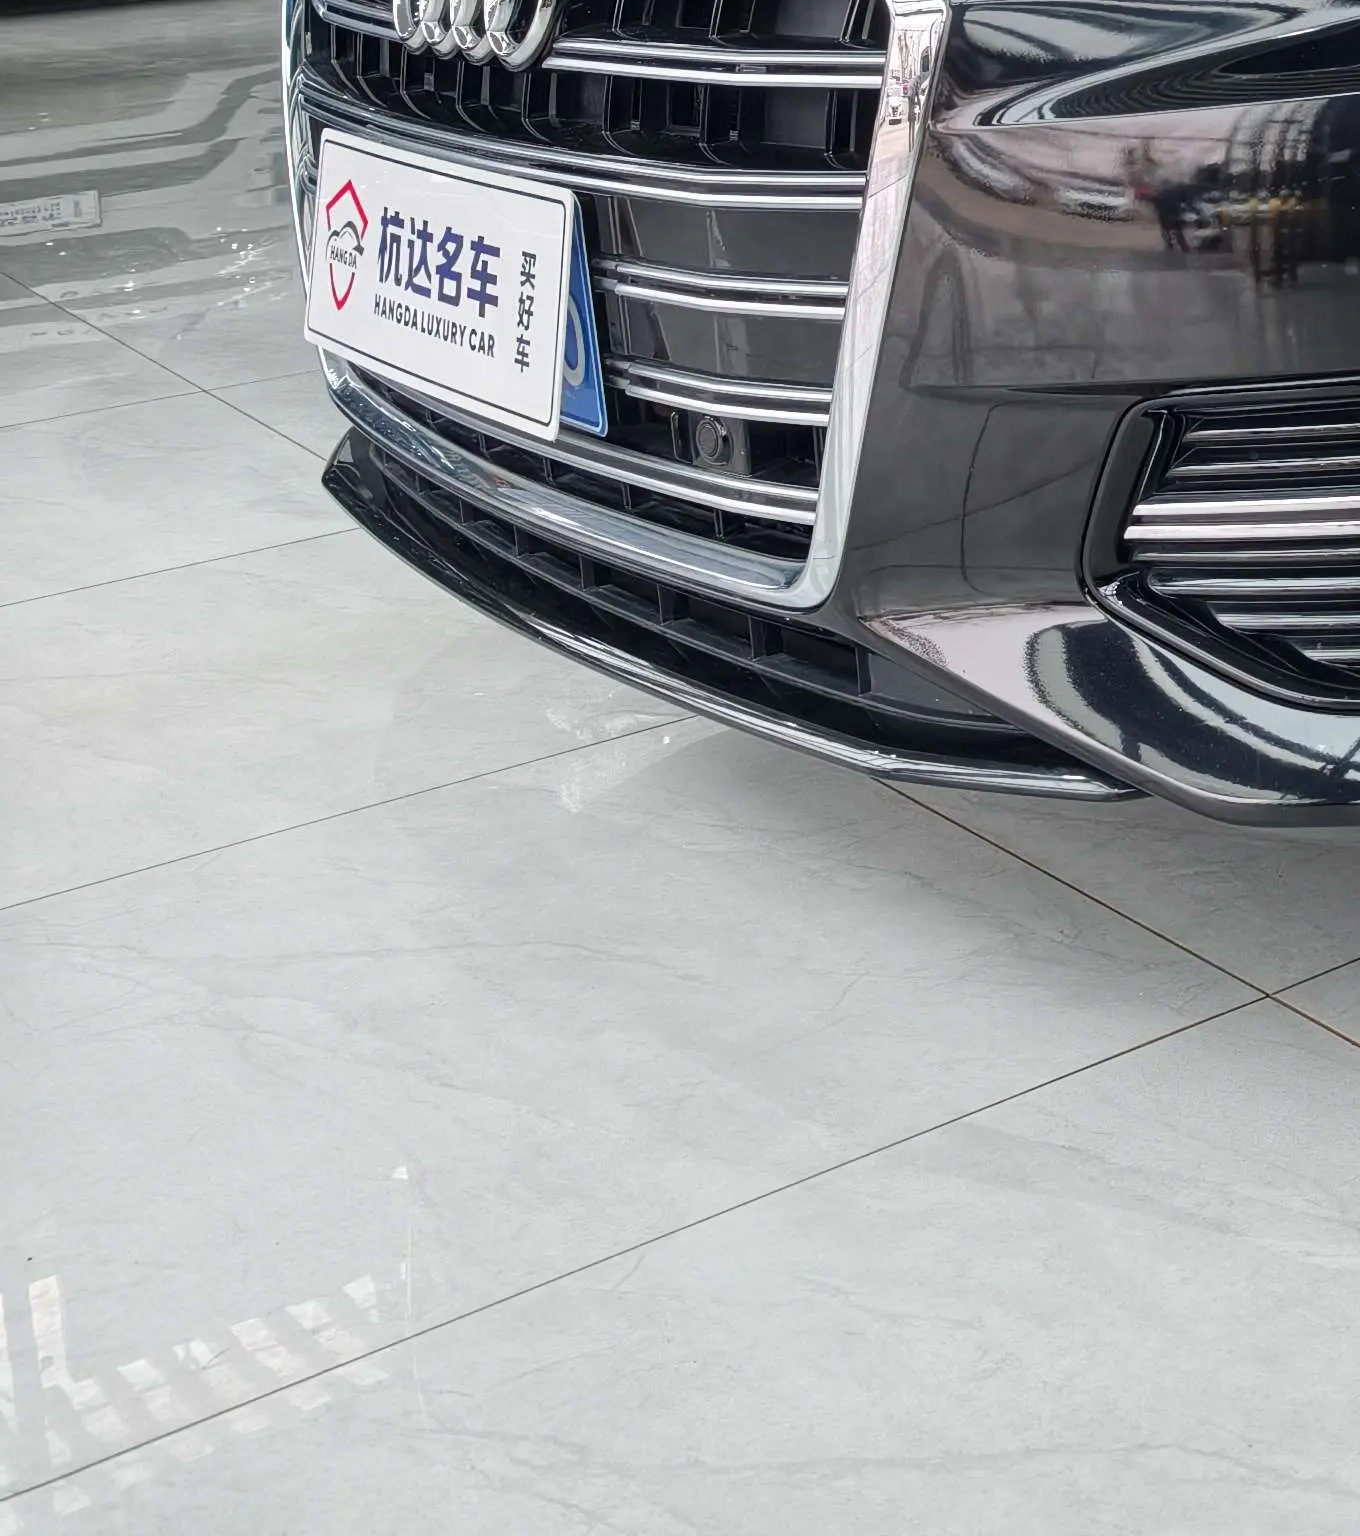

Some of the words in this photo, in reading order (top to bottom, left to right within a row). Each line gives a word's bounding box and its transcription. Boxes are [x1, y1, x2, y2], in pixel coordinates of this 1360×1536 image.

[330, 244, 348, 265] HANG
[348, 253, 357, 269] DA
[377, 207, 501, 318] 杭达名车
[374, 293, 418, 330] HANGDA
[421, 310, 467, 347] LUXURY
[469, 328, 495, 358] CAR
[514, 251, 537, 373] 买好车
